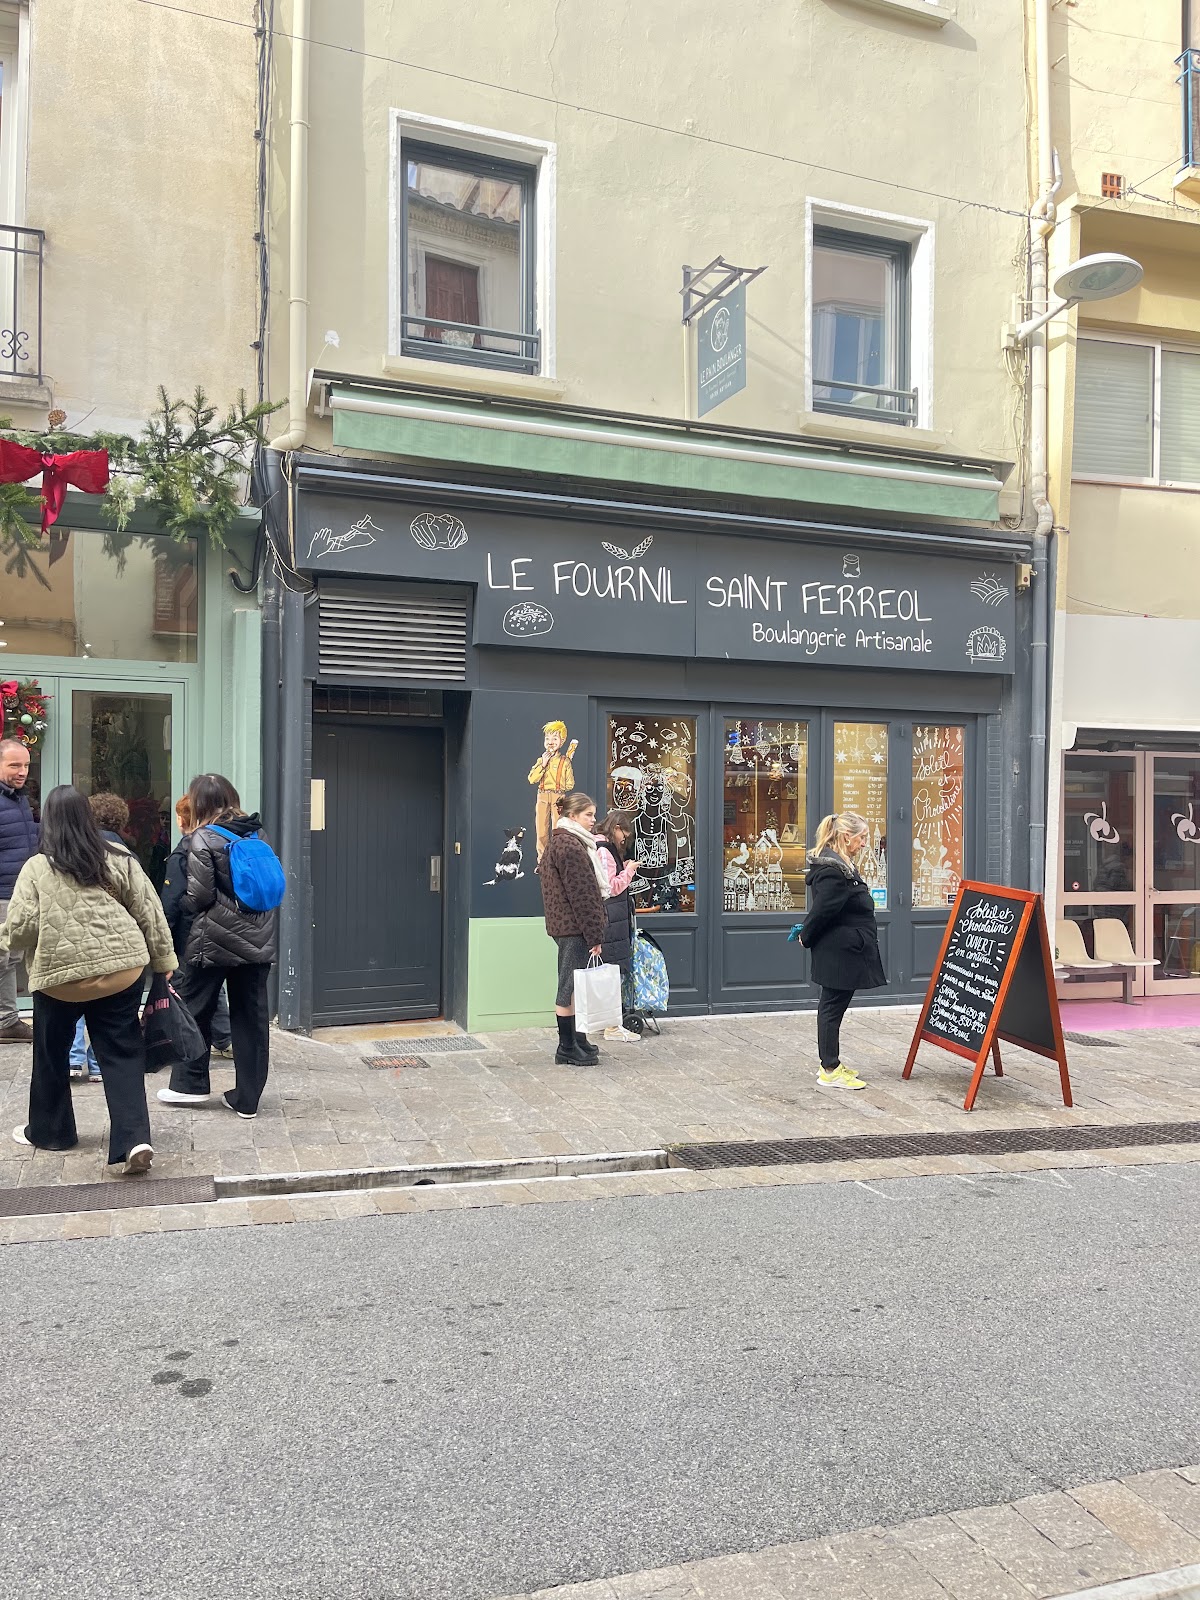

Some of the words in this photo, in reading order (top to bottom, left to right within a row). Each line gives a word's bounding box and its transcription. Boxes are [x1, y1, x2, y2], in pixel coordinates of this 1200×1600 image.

[700, 370, 706, 384] LE
[706, 362, 717, 380] PAIN
[717, 343, 742, 371] BOULANGER
[487, 552, 535, 591] LE
[553, 560, 688, 604] FOURNIL
[706, 573, 788, 612] SAINT
[801, 582, 933, 622] FERREOL
[752, 620, 847, 655] Boulangerie
[855, 629, 933, 653] Artisanale
[915, 751, 955, 781] Soleil
[937, 774, 952, 787] et
[913, 775, 962, 821] Chocolatine
[966, 899, 999, 919] Soleil
[959, 917, 1014, 935] Chocolatine
[965, 934, 996, 956] OUVERT
[955, 948, 965, 957] en
[966, 951, 993, 966] continu
[939, 984, 960, 1001] SNACK
[154, 997, 170, 1010] Hill
